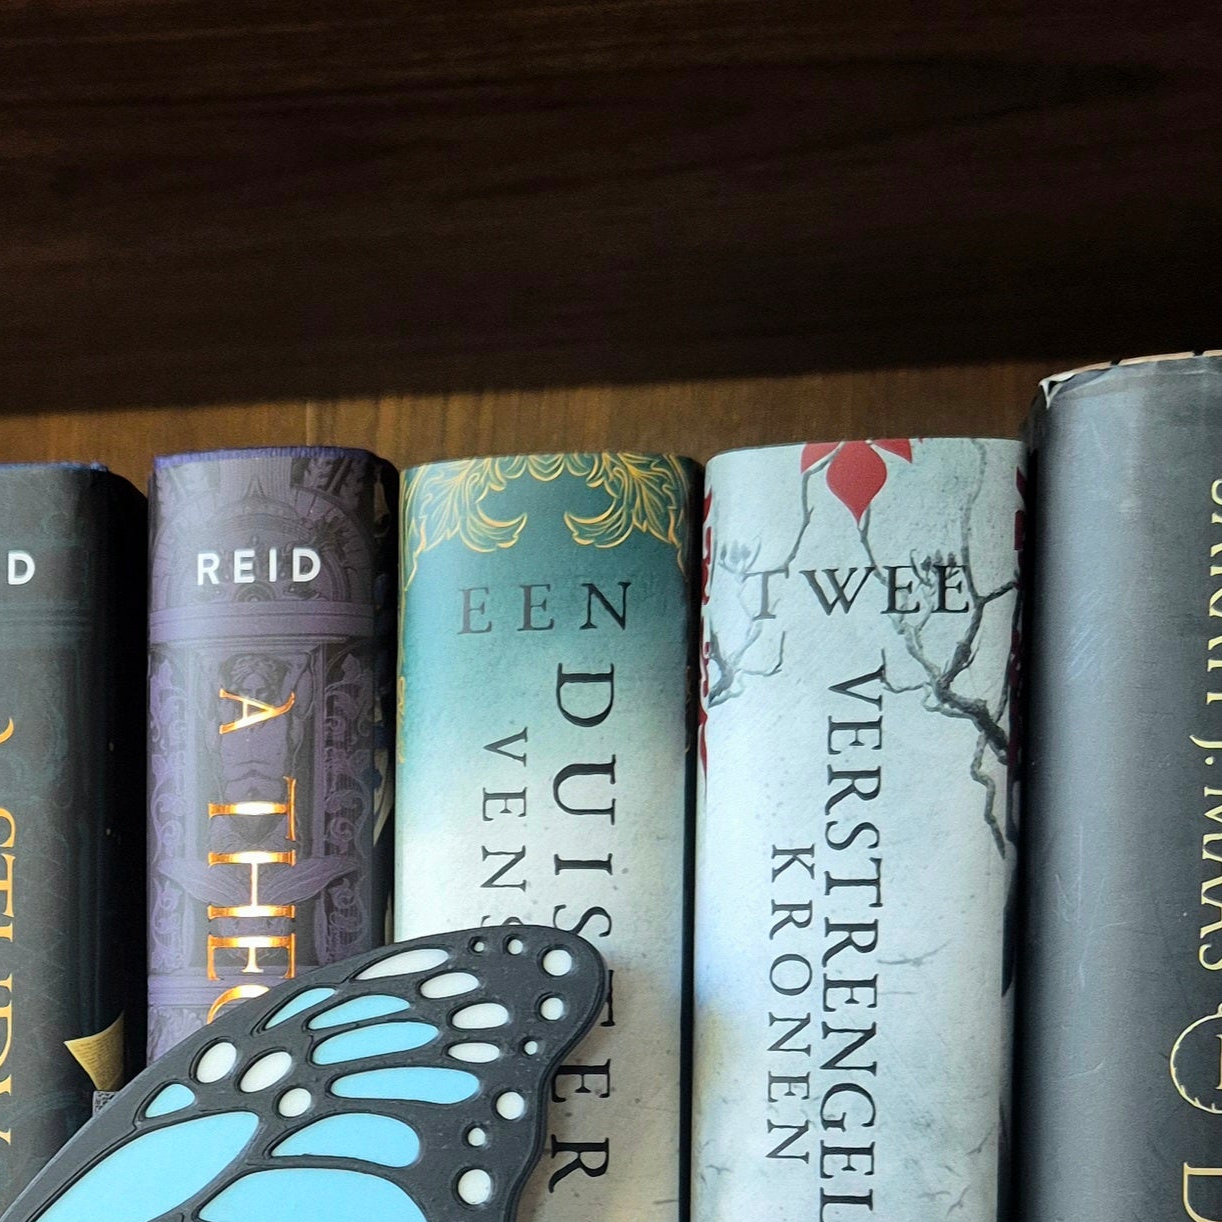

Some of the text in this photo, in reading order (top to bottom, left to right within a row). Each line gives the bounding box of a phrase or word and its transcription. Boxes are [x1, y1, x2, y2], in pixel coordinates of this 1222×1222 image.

[196, 547, 323, 587] REID
[742, 563, 973, 621] TWEE
[456, 580, 632, 636] EEN
[218, 687, 296, 735] A
[480, 726, 529, 930] VEN
[764, 843, 816, 1165] KRONEN
